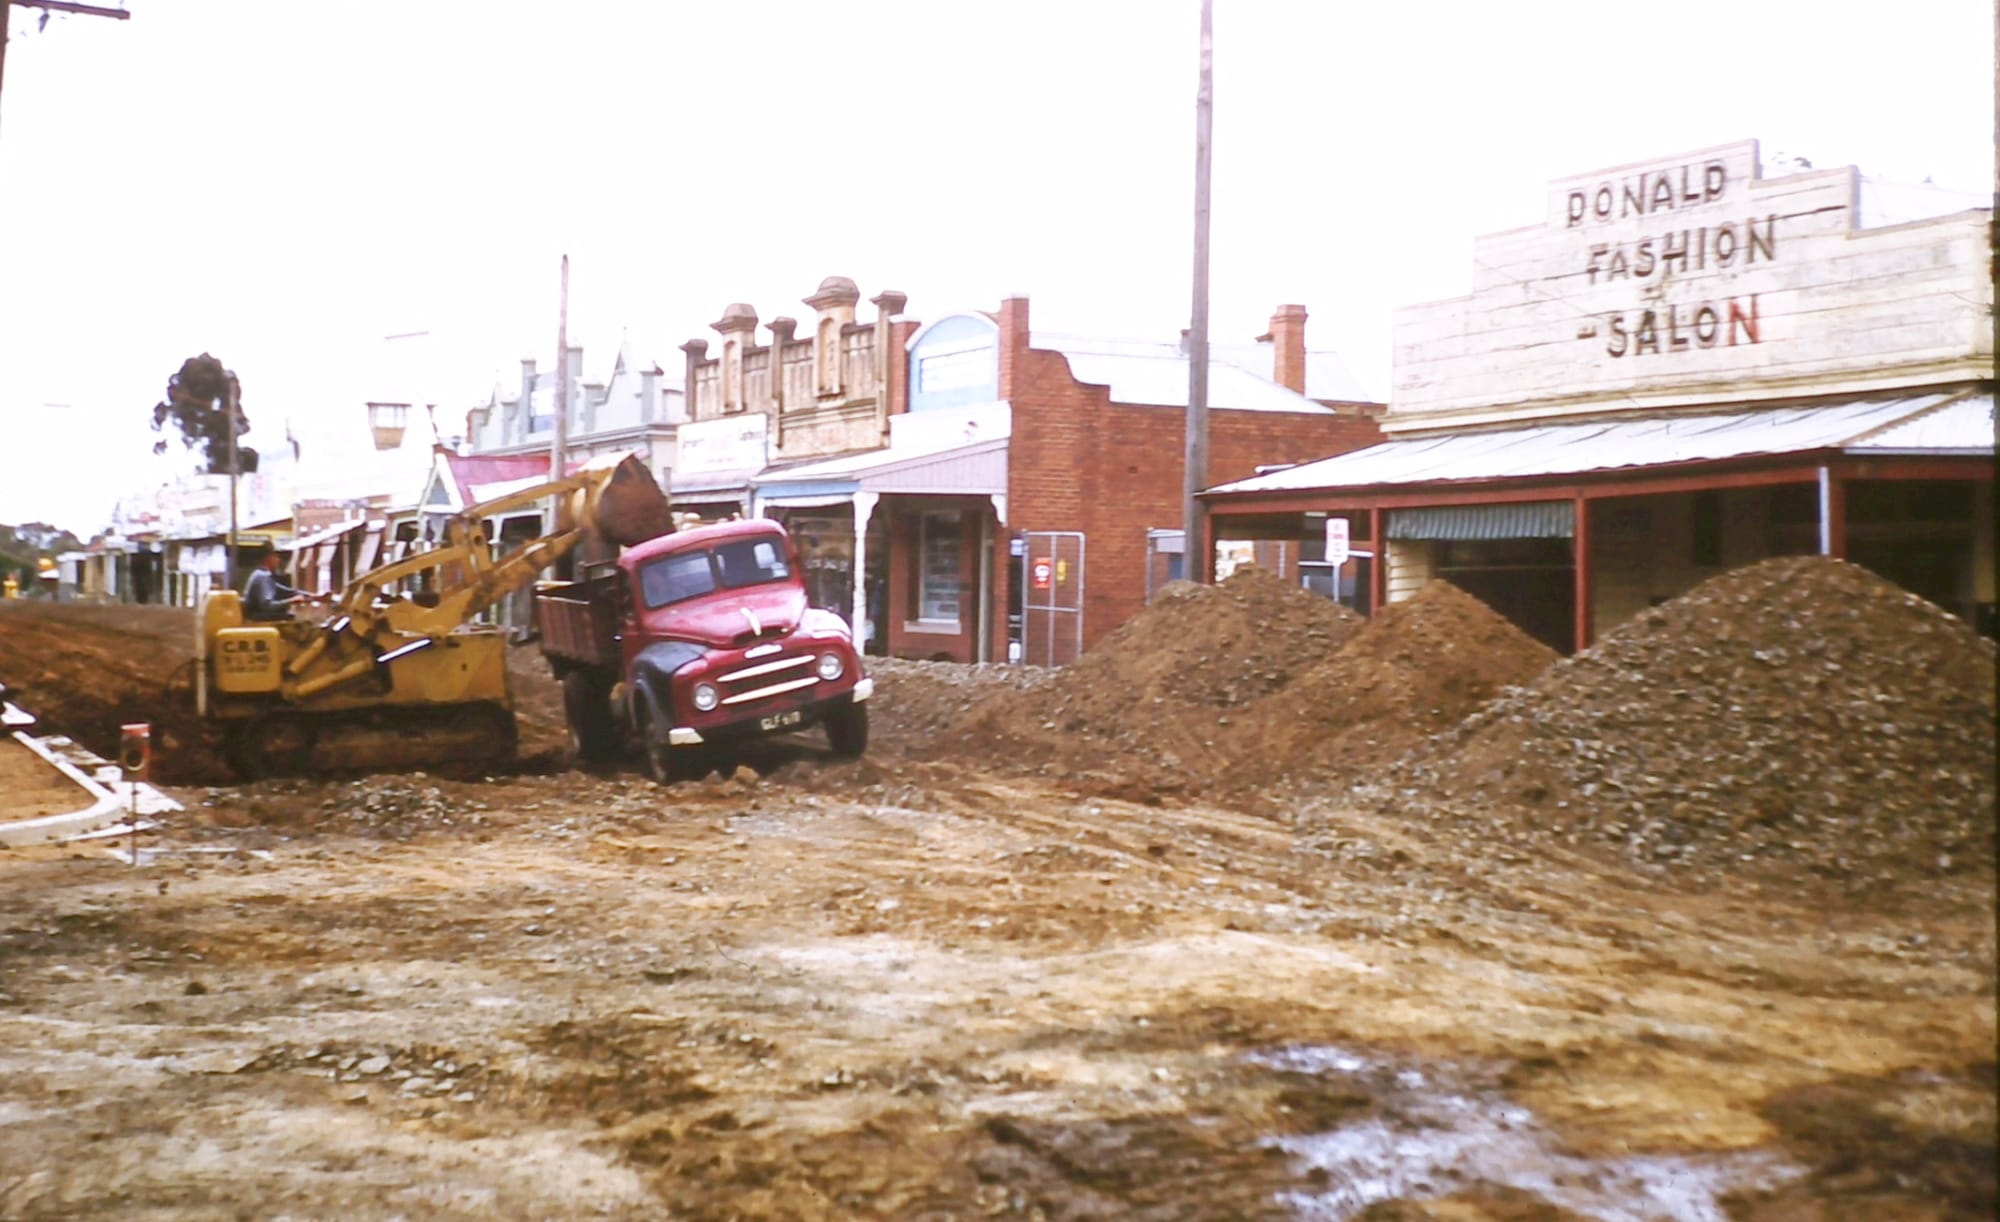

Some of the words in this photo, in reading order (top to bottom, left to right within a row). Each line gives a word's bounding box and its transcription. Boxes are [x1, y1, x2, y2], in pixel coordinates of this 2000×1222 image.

[1567, 161, 1726, 228] DONALD
[1586, 214, 1776, 285] FASHION
[1607, 293, 1760, 358] SALON
